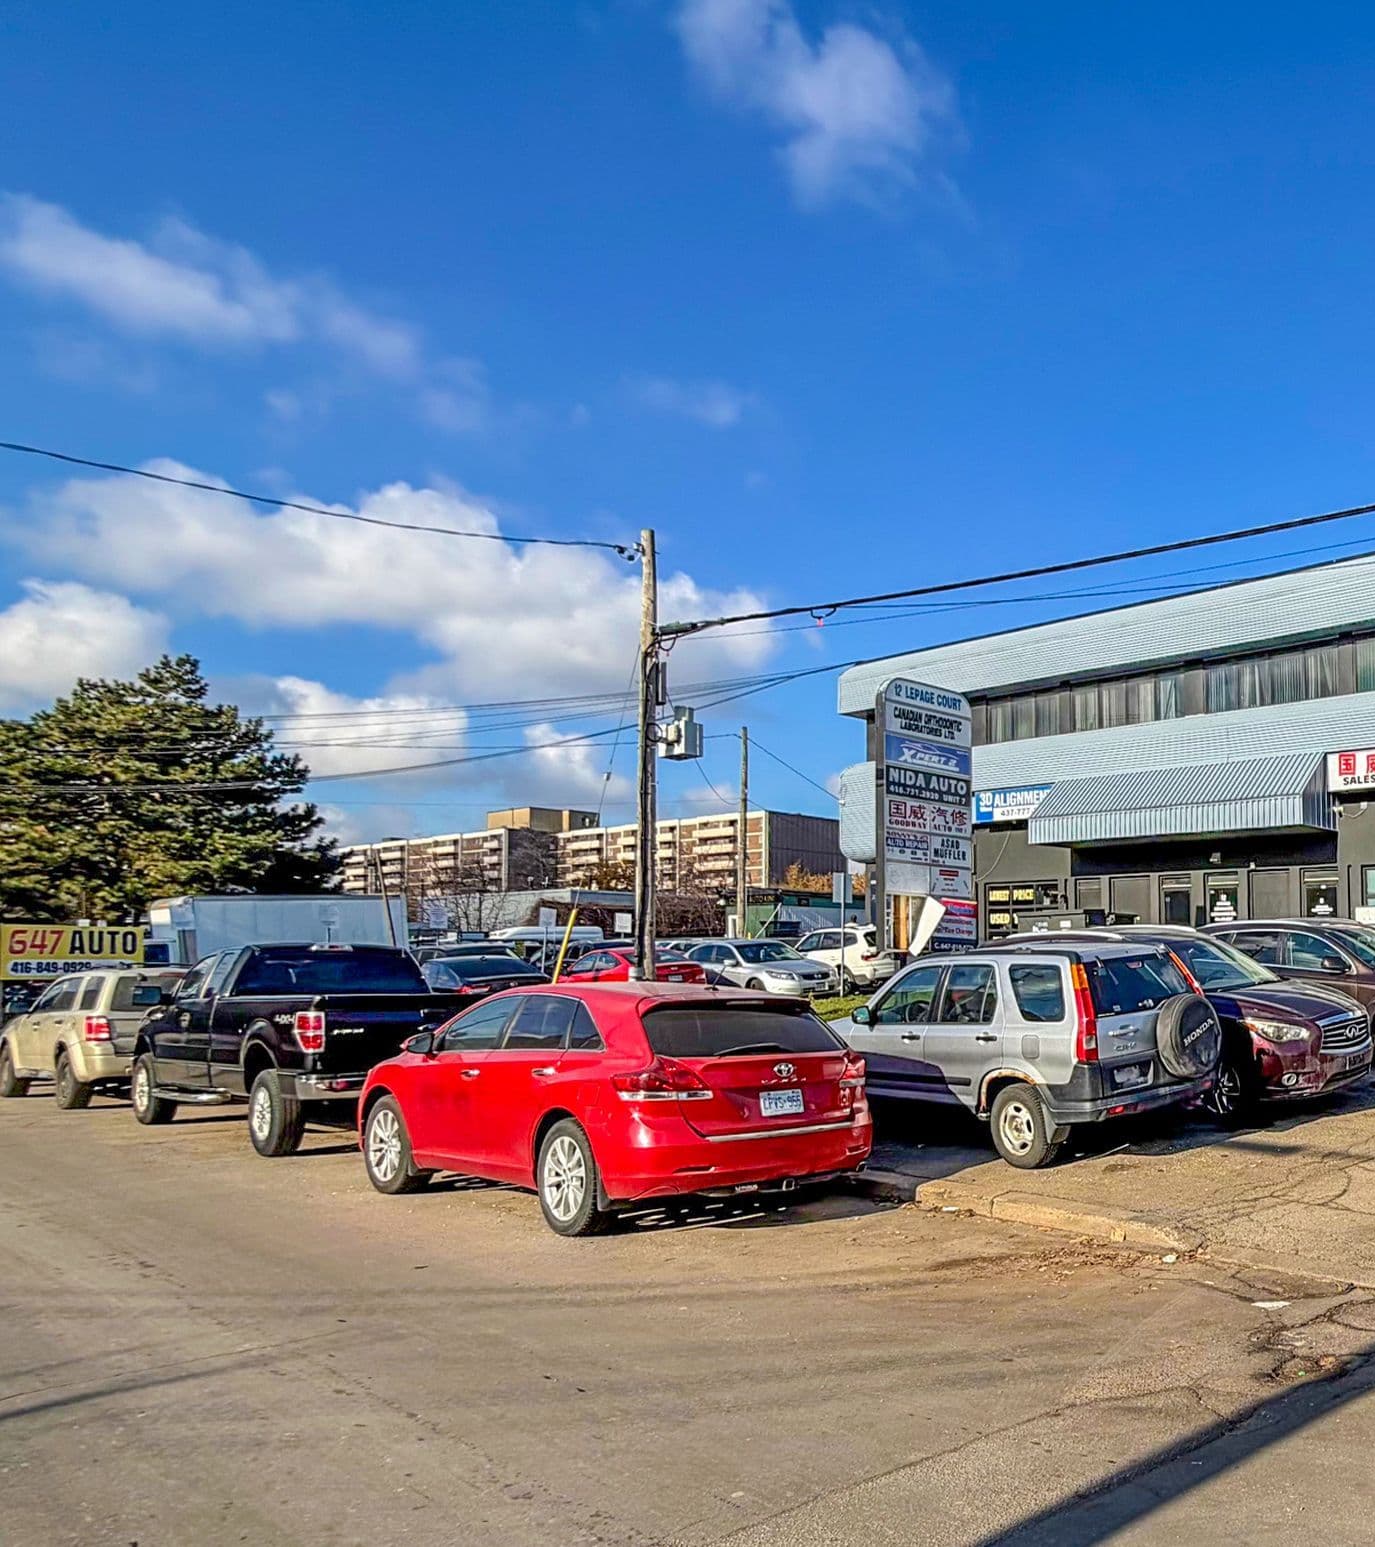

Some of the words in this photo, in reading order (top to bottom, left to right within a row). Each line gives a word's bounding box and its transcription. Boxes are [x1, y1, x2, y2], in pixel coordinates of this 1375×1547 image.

[894, 683, 902, 697] 12
[905, 686, 935, 704] LEPAGE
[936, 695, 962, 711] COURT
[893, 706, 923, 723] CANADIAN
[924, 713, 962, 732] ORTHODONTIC
[900, 720, 942, 737] LABORATORIES
[889, 767, 926, 788] NIDA
[929, 775, 967, 795] AUTO
[942, 794, 960, 803] UNIT
[979, 792, 993, 806] 3D
[888, 818, 927, 829] GOODWAY
[933, 823, 953, 833] AUTO
[941, 838, 960, 850] ASAD
[933, 847, 967, 861] MUFFLER
[8, 929, 64, 955] 647
[68, 930, 137, 955] AUTO
[1183, 1018, 1215, 1047] HONDA
